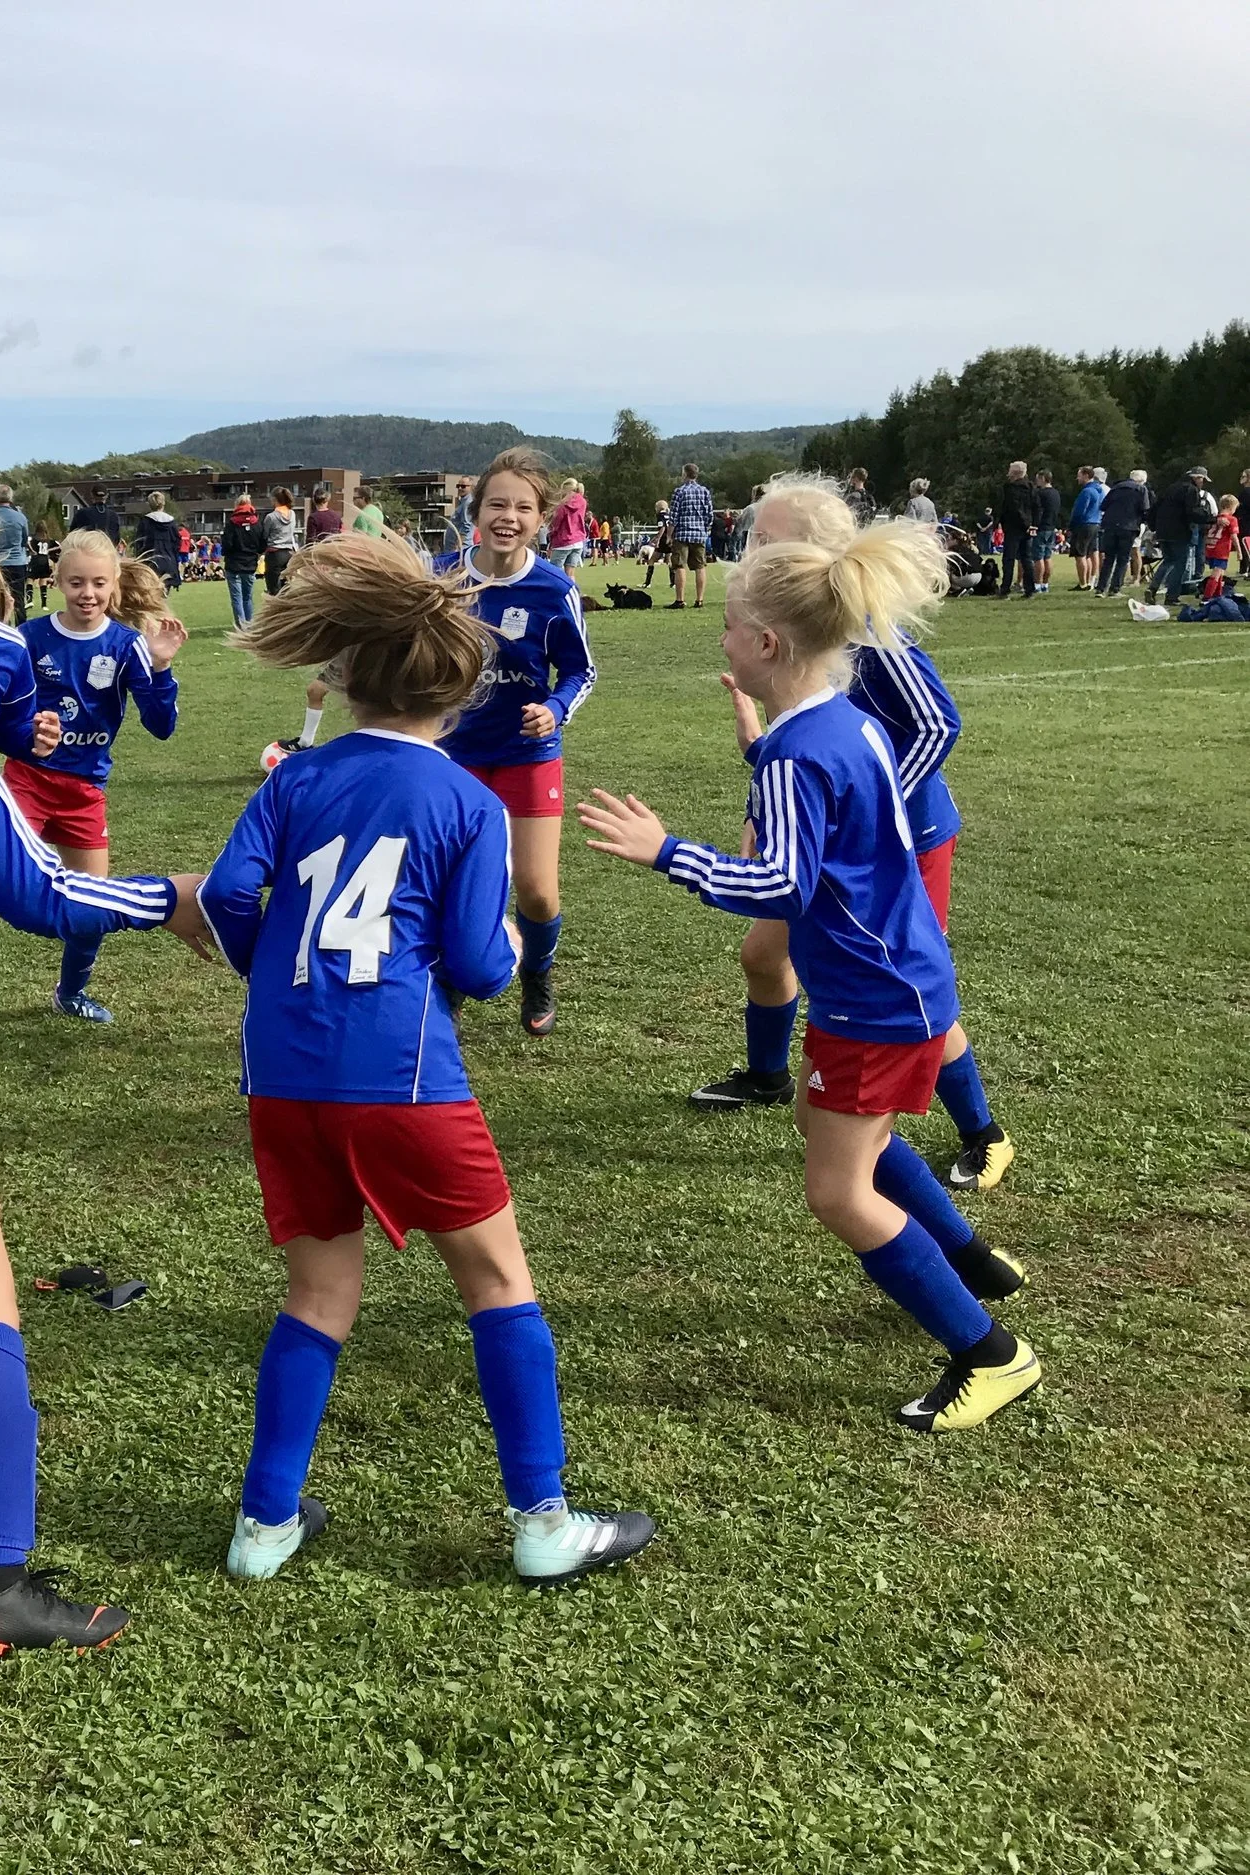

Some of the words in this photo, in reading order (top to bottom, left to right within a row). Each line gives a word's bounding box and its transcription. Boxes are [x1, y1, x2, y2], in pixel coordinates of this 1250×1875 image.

[481, 669, 536, 688] OLVO
[59, 731, 110, 746] OLVO
[292, 834, 407, 987] 14
